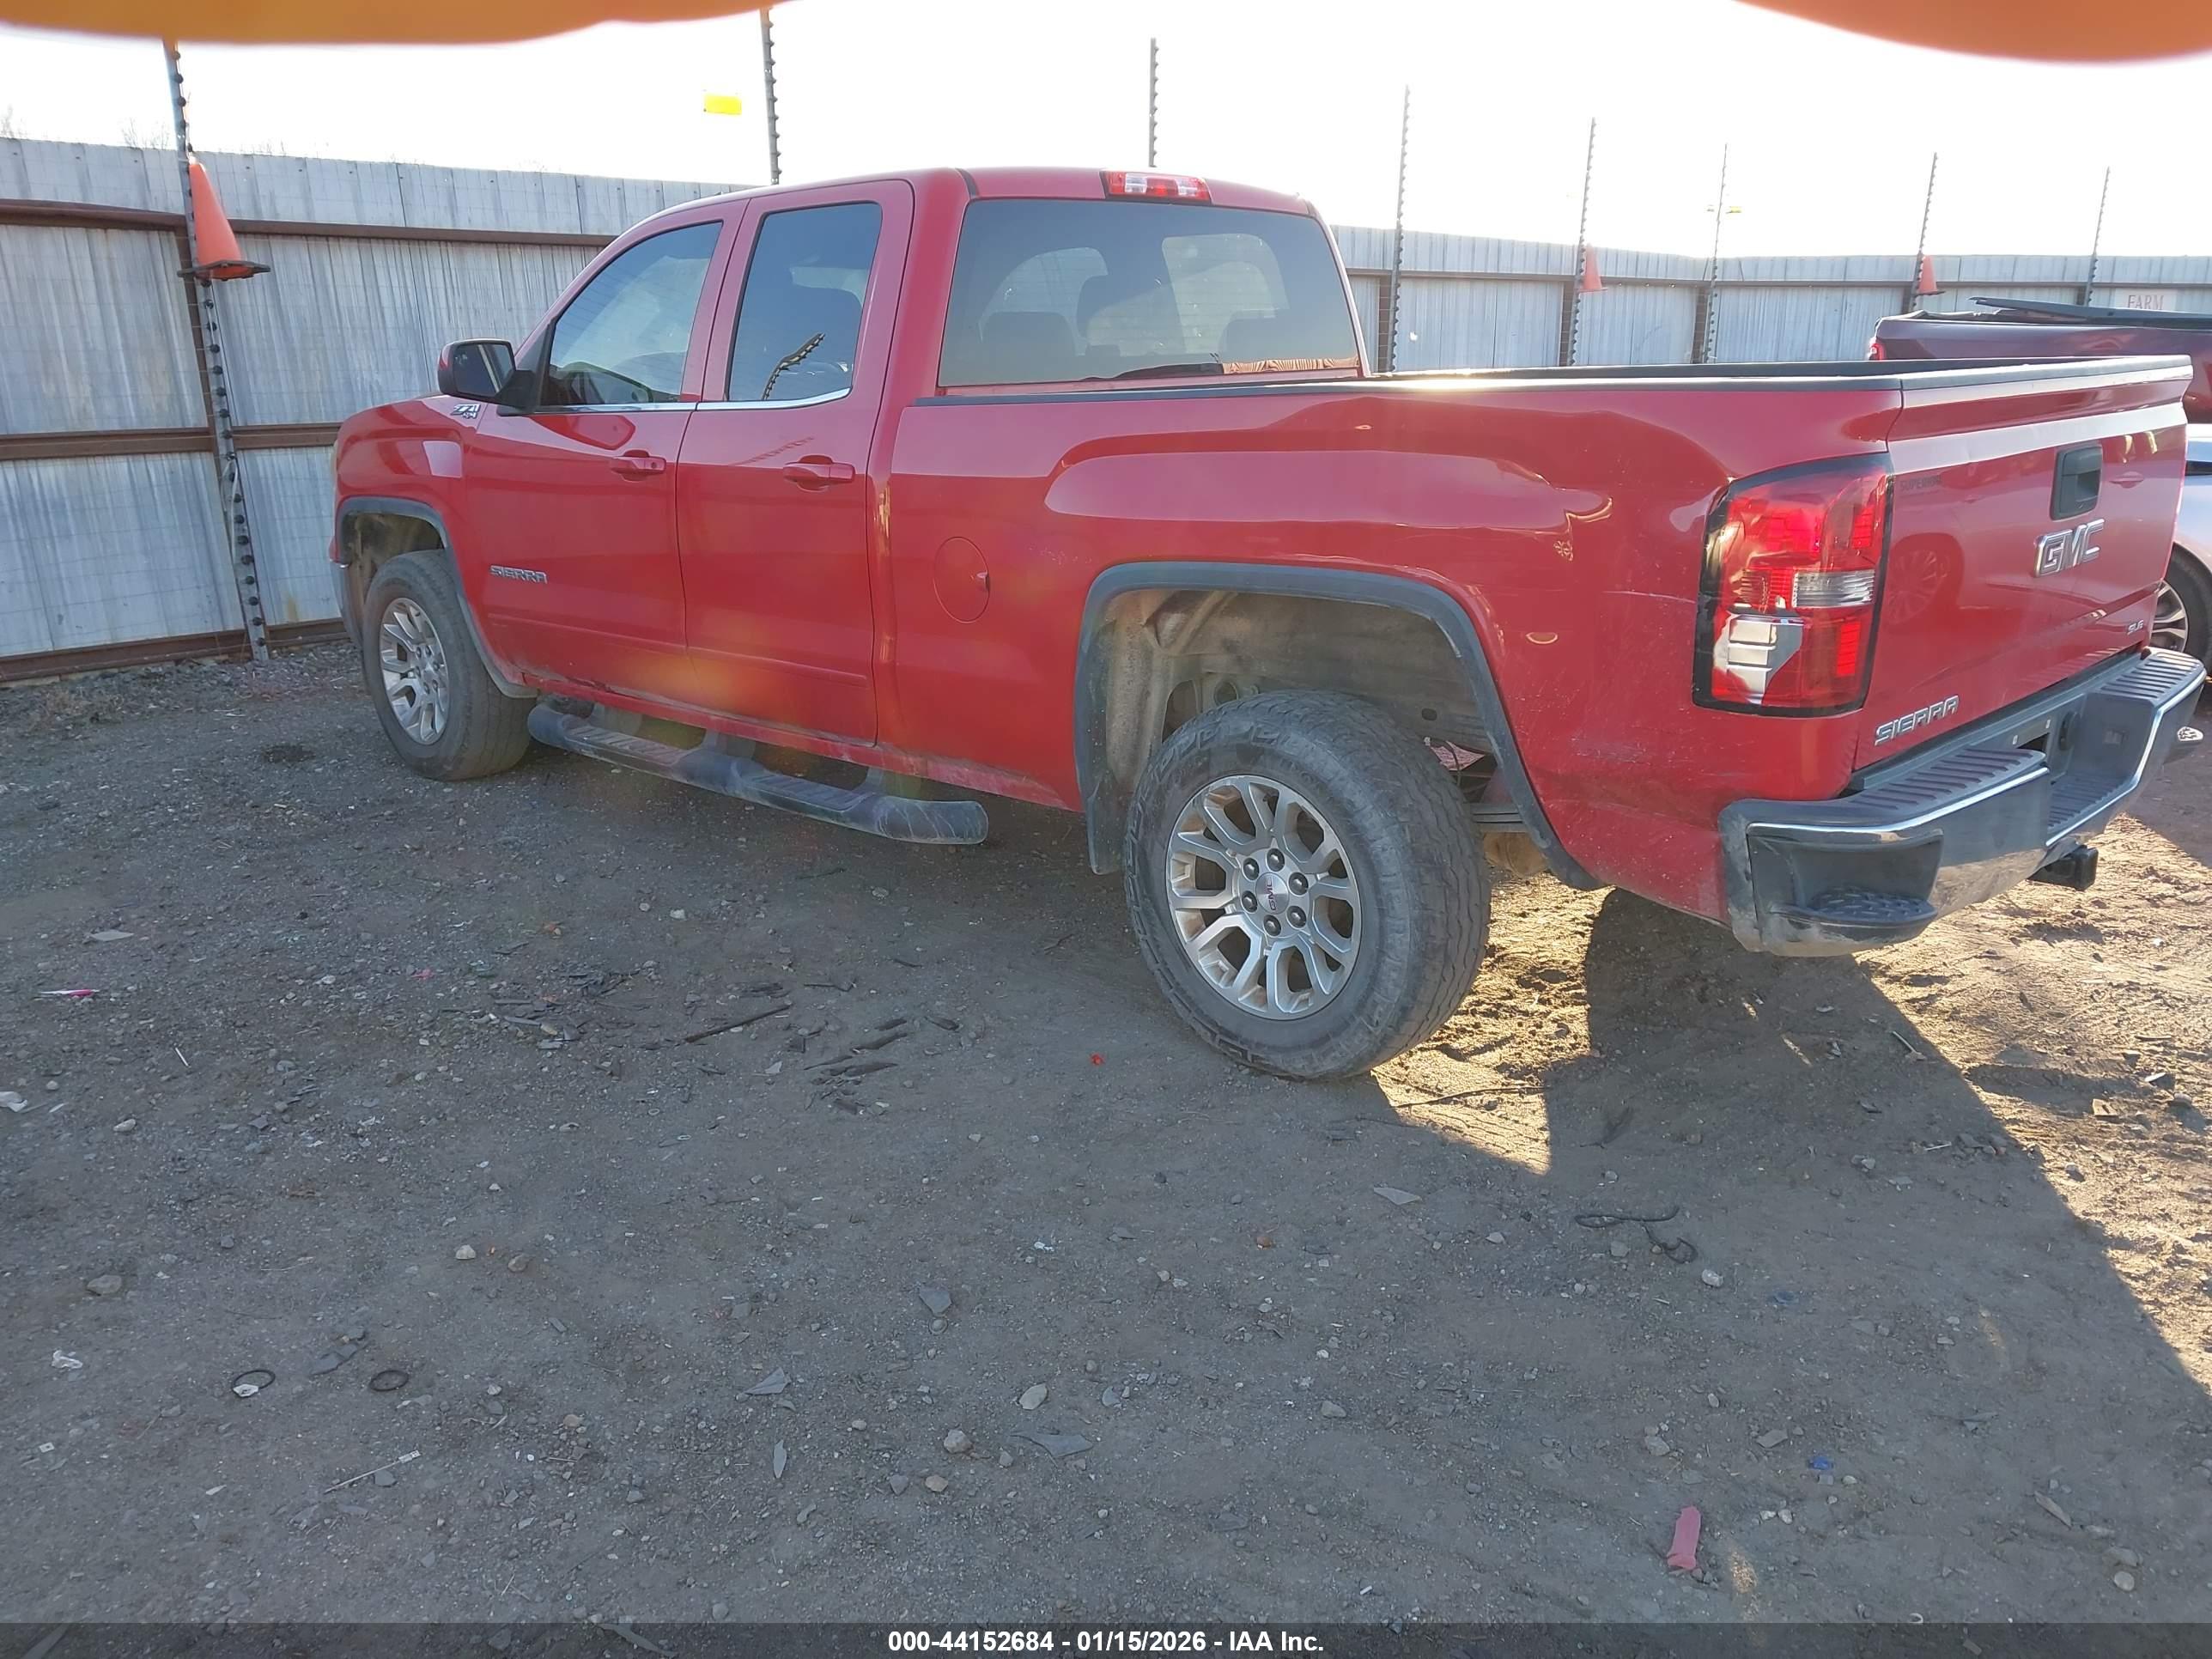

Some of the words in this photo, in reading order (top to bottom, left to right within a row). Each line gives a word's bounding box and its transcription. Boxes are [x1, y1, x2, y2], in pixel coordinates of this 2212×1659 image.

[2127, 295, 2165, 311] FARM
[2033, 518, 2106, 578] GMC
[489, 564, 548, 585] SIERRA
[1875, 694, 1960, 746] SIERRA
[1264, 876, 1277, 911] GMC
